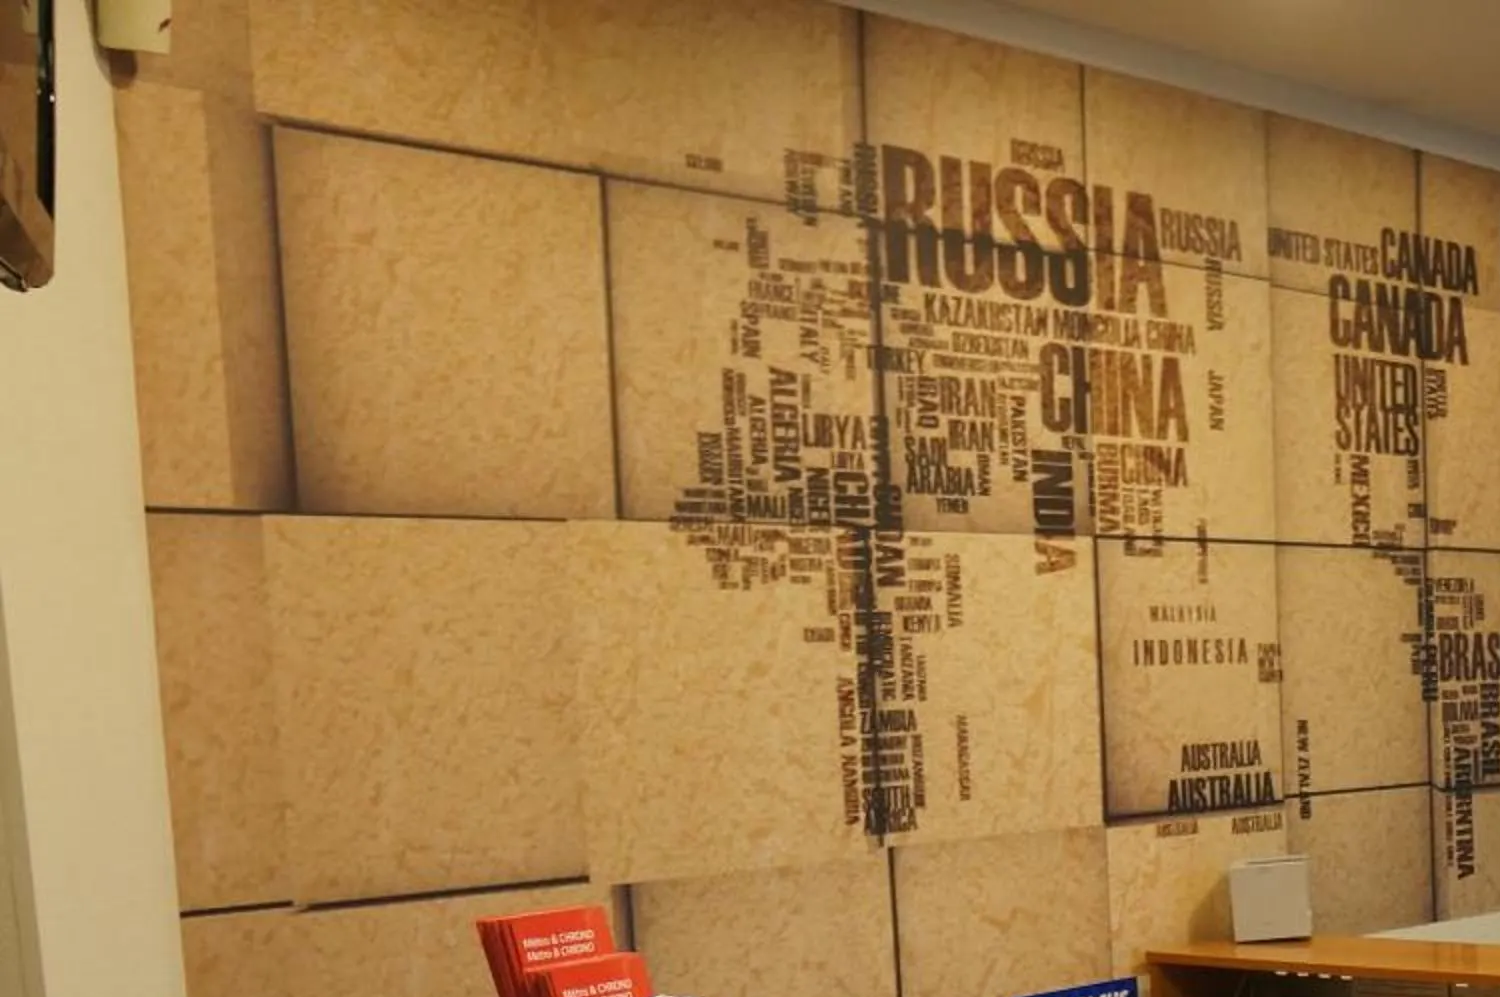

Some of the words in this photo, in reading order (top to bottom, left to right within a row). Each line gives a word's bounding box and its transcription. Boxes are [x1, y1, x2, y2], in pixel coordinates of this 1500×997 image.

[881, 144, 1168, 316] RUSSIA
[1160, 207, 1242, 262] RUSSIA
[1268, 227, 1320, 265] UNITED
[1324, 238, 1379, 275] STATES
[1381, 227, 1478, 296] CANADA
[1205, 257, 1224, 331] RUSSIA
[1330, 274, 1469, 365] CANADA
[741, 300, 761, 359] SPAIN
[800, 311, 820, 363] ITALY
[917, 376, 939, 429] IRAQ
[940, 376, 996, 418] IRAN
[1039, 342, 1189, 443] CHINA
[1208, 370, 1224, 430] JAPAN
[1334, 354, 1418, 412] UNITED
[748, 394, 769, 465] ALGERIA
[768, 366, 801, 482] ALGERIA
[802, 413, 866, 450] LIBYA
[948, 419, 995, 452] IRAN
[1010, 396, 1028, 482] PAKISTAN
[1334, 394, 1419, 457] STATES
[726, 427, 746, 522] MAURITANIA
[831, 451, 865, 469] LIBYA
[906, 457, 976, 496] ARABIA
[976, 453, 991, 496] OMAN
[1097, 443, 1120, 532] BURMA
[1120, 443, 1188, 487] CHINA
[746, 494, 787, 519] MALI
[1031, 450, 1077, 575] INDIA
[945, 553, 963, 628] SOMALIA
[1149, 605, 1217, 622] MALAYSIA
[1133, 638, 1249, 667] INDONESIA
[836, 674, 858, 747] ANGOLA
[860, 709, 918, 735] ZMBIA
[1297, 720, 1309, 752] NEW
[1181, 739, 1263, 772] AUSTRALIA
[1168, 770, 1276, 815] AUSTRALIA
